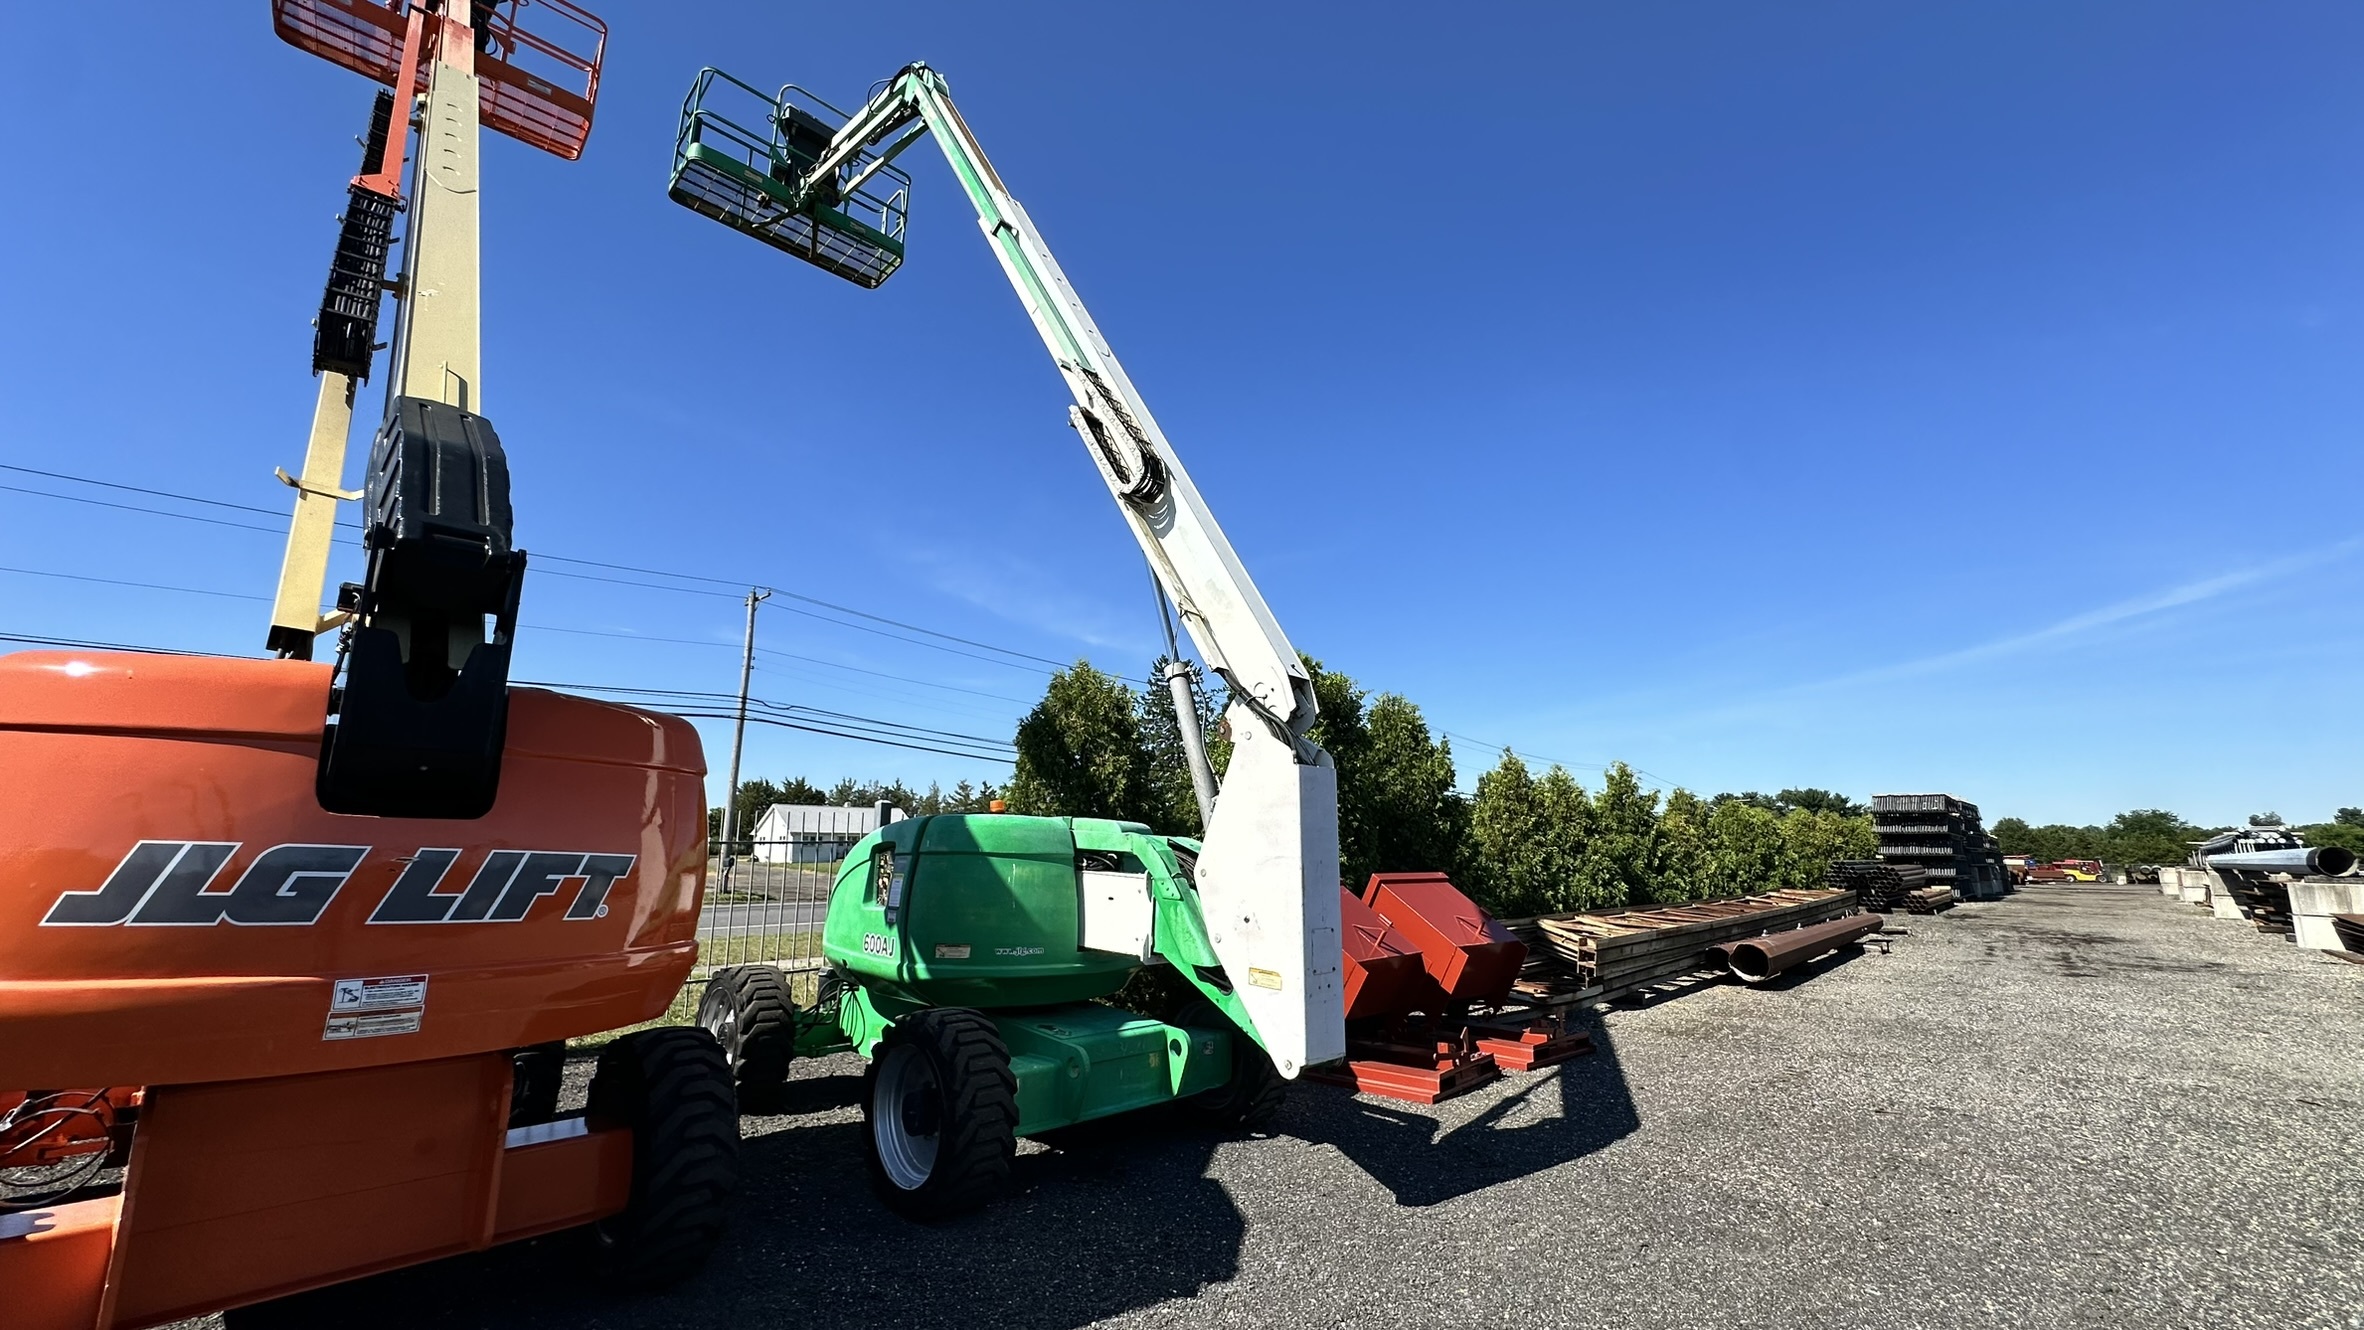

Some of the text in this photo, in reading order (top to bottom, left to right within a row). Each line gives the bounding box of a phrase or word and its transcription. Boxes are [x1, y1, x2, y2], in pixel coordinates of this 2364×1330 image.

[39, 840, 637, 926] JLG LIFT
[864, 932, 896, 957] 600AJ
